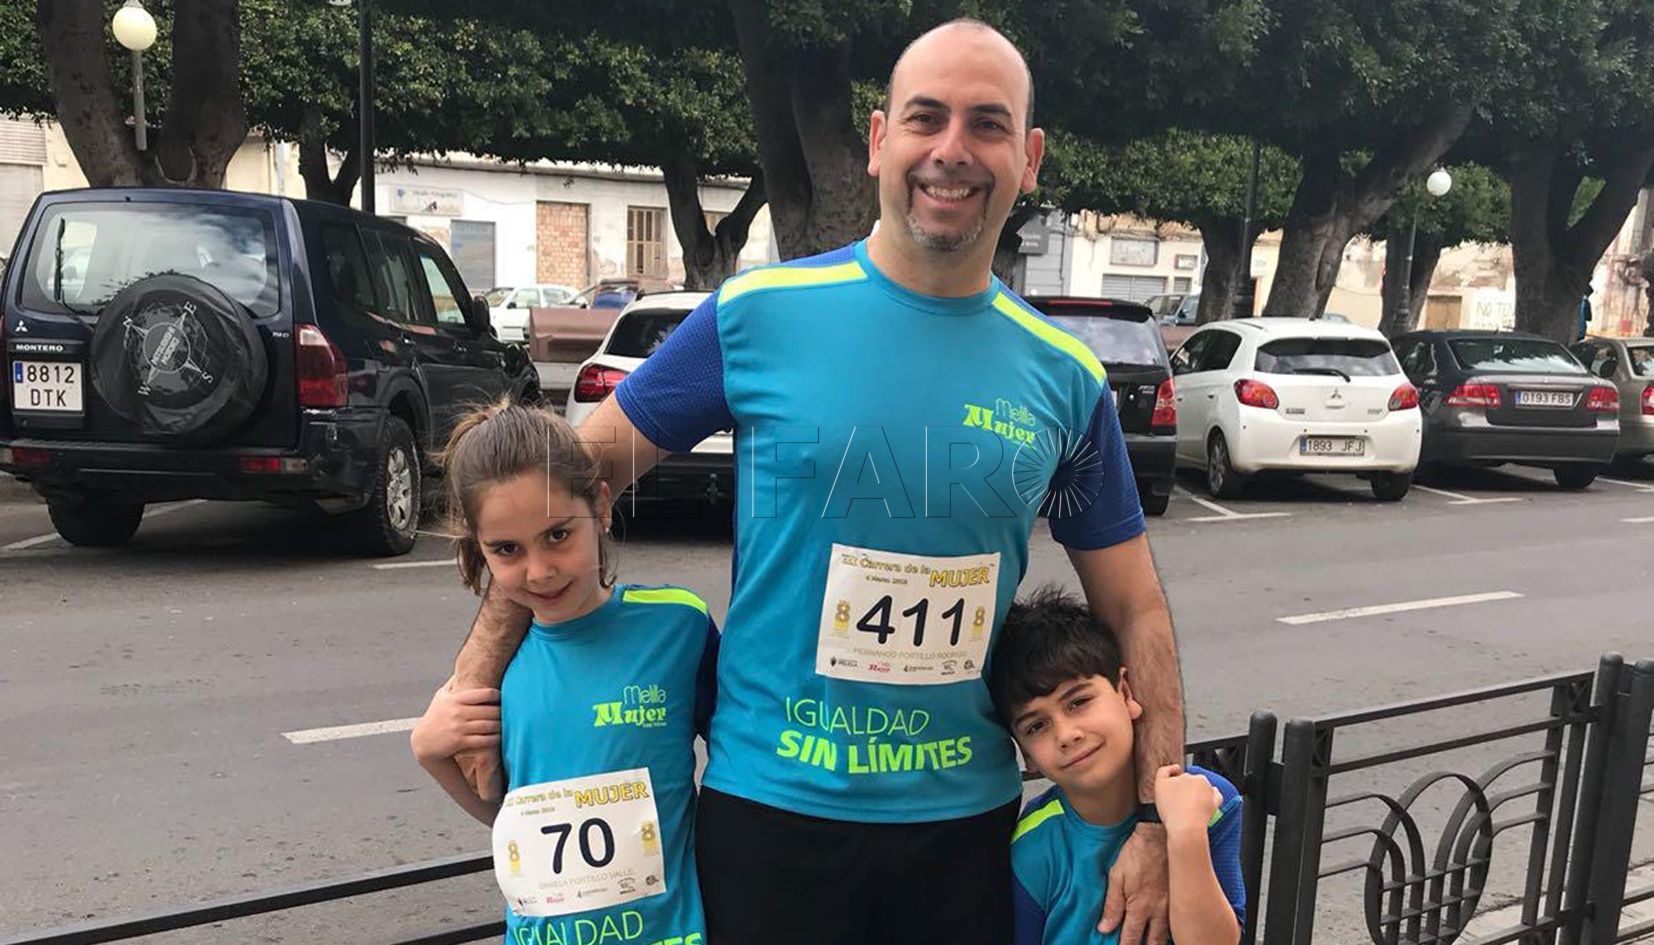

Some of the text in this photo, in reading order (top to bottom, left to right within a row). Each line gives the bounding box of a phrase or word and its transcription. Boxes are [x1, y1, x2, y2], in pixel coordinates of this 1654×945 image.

[183, 301, 197, 315] E
[16, 344, 64, 352] MONTERO
[27, 366, 75, 383] 8812
[31, 389, 67, 407] DTK
[1522, 392, 1549, 403] 0193
[963, 404, 1036, 443] Mujer
[1308, 440, 1362, 451] 1893 JFJ
[860, 556, 901, 572] Carrera
[905, 563, 918, 574] de
[929, 567, 990, 588] MUJER
[856, 595, 965, 647] 411
[592, 702, 667, 727] Mujer
[786, 696, 930, 736] IGUALDAD
[776, 729, 973, 774] SIN LÍMITES
[575, 781, 649, 808] MUJER
[541, 818, 615, 874] 70
